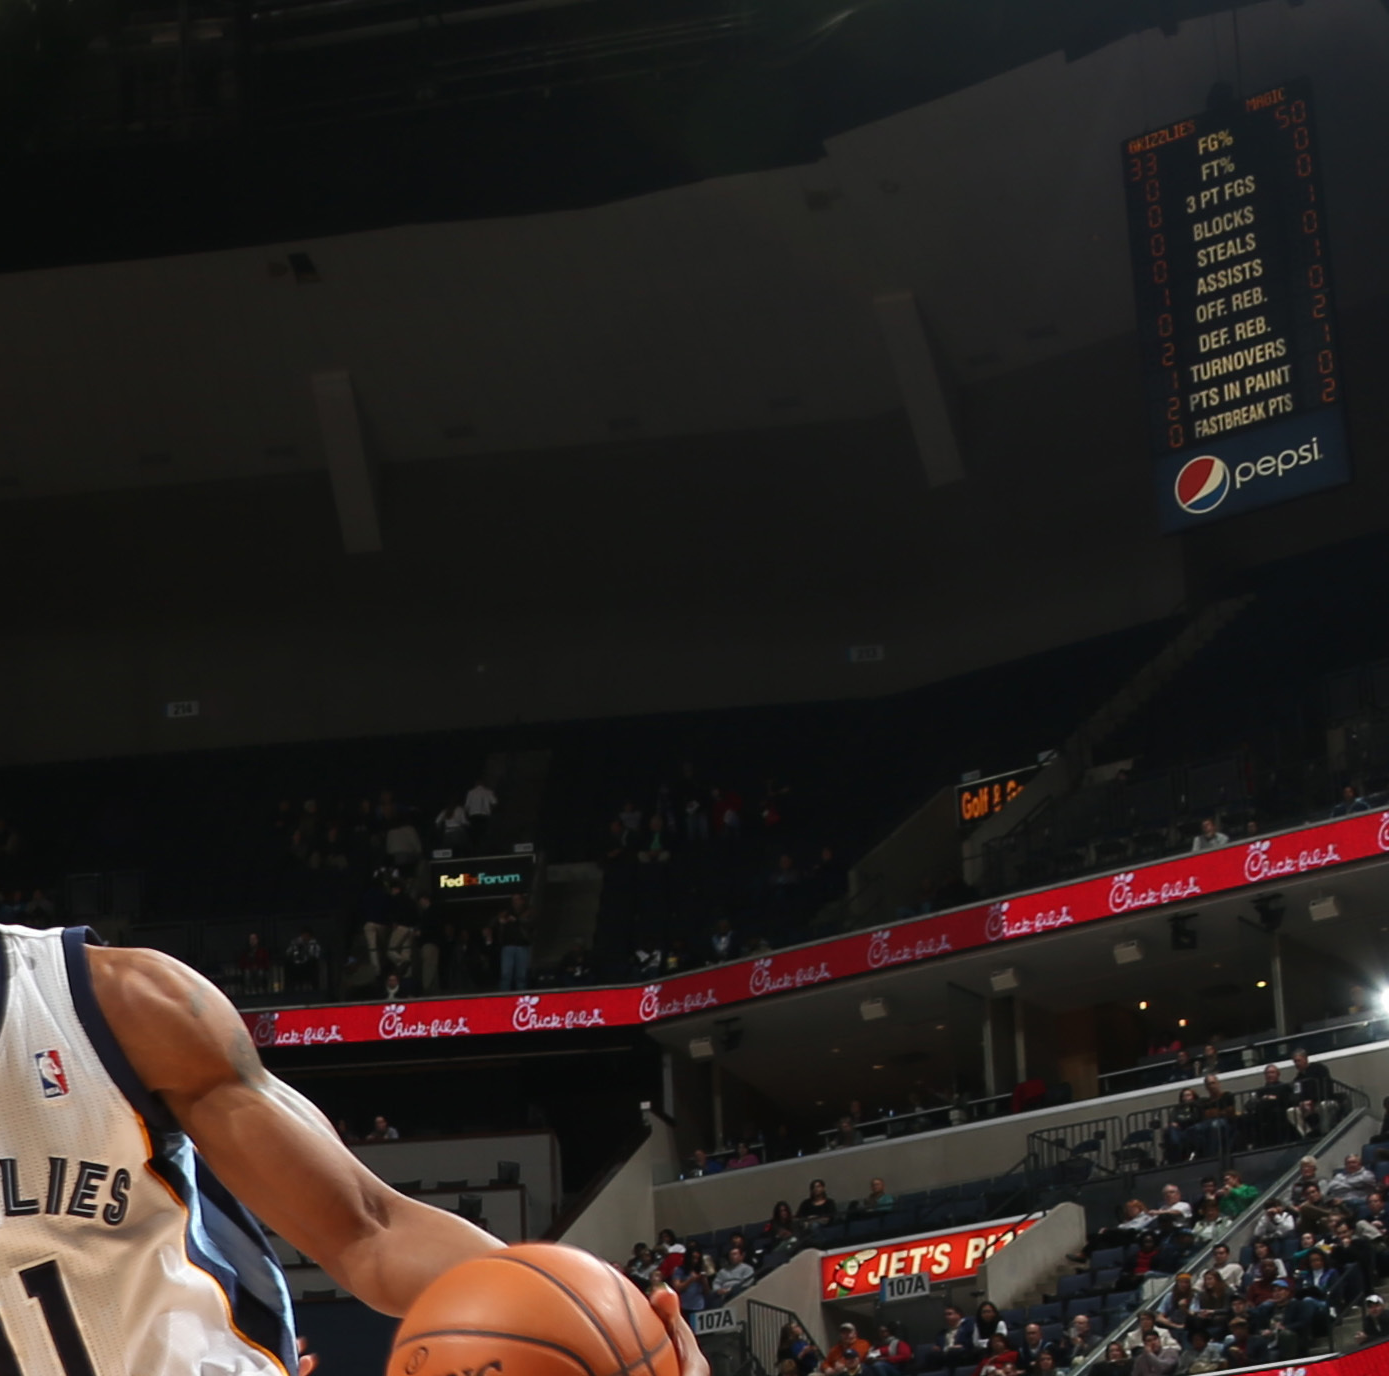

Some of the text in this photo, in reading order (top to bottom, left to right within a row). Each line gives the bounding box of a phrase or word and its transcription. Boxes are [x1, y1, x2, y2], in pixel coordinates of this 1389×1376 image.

[1198, 129, 1234, 155] FG%
[1201, 156, 1236, 181] FT%
[1186, 195, 1198, 214] 3
[1200, 186, 1220, 209] PT
[1224, 175, 1256, 200] FGS
[1193, 205, 1255, 241] BLOCKS
[1197, 232, 1256, 267] STEALS
[1196, 258, 1264, 296] ASSISTS
[1195, 298, 1228, 324] OFF.
[1232, 286, 1269, 312] REB.
[1198, 327, 1231, 353] DEF.
[1235, 316, 1272, 342] REB.
[1190, 338, 1287, 383] TURNOVERS
[1189, 387, 1220, 412] PTS
[1223, 381, 1241, 402] IN
[1245, 364, 1292, 395] PAINT
[1195, 401, 1266, 438] FASTBREAK
[1267, 393, 1294, 417] PTS
[1234, 436, 1321, 489] pepsi
[439, 872, 521, 888] FedExForum
[867, 1243, 952, 1285] JET'S
[887, 1275, 927, 1298] 107A
[698, 1310, 734, 1331] 107A
